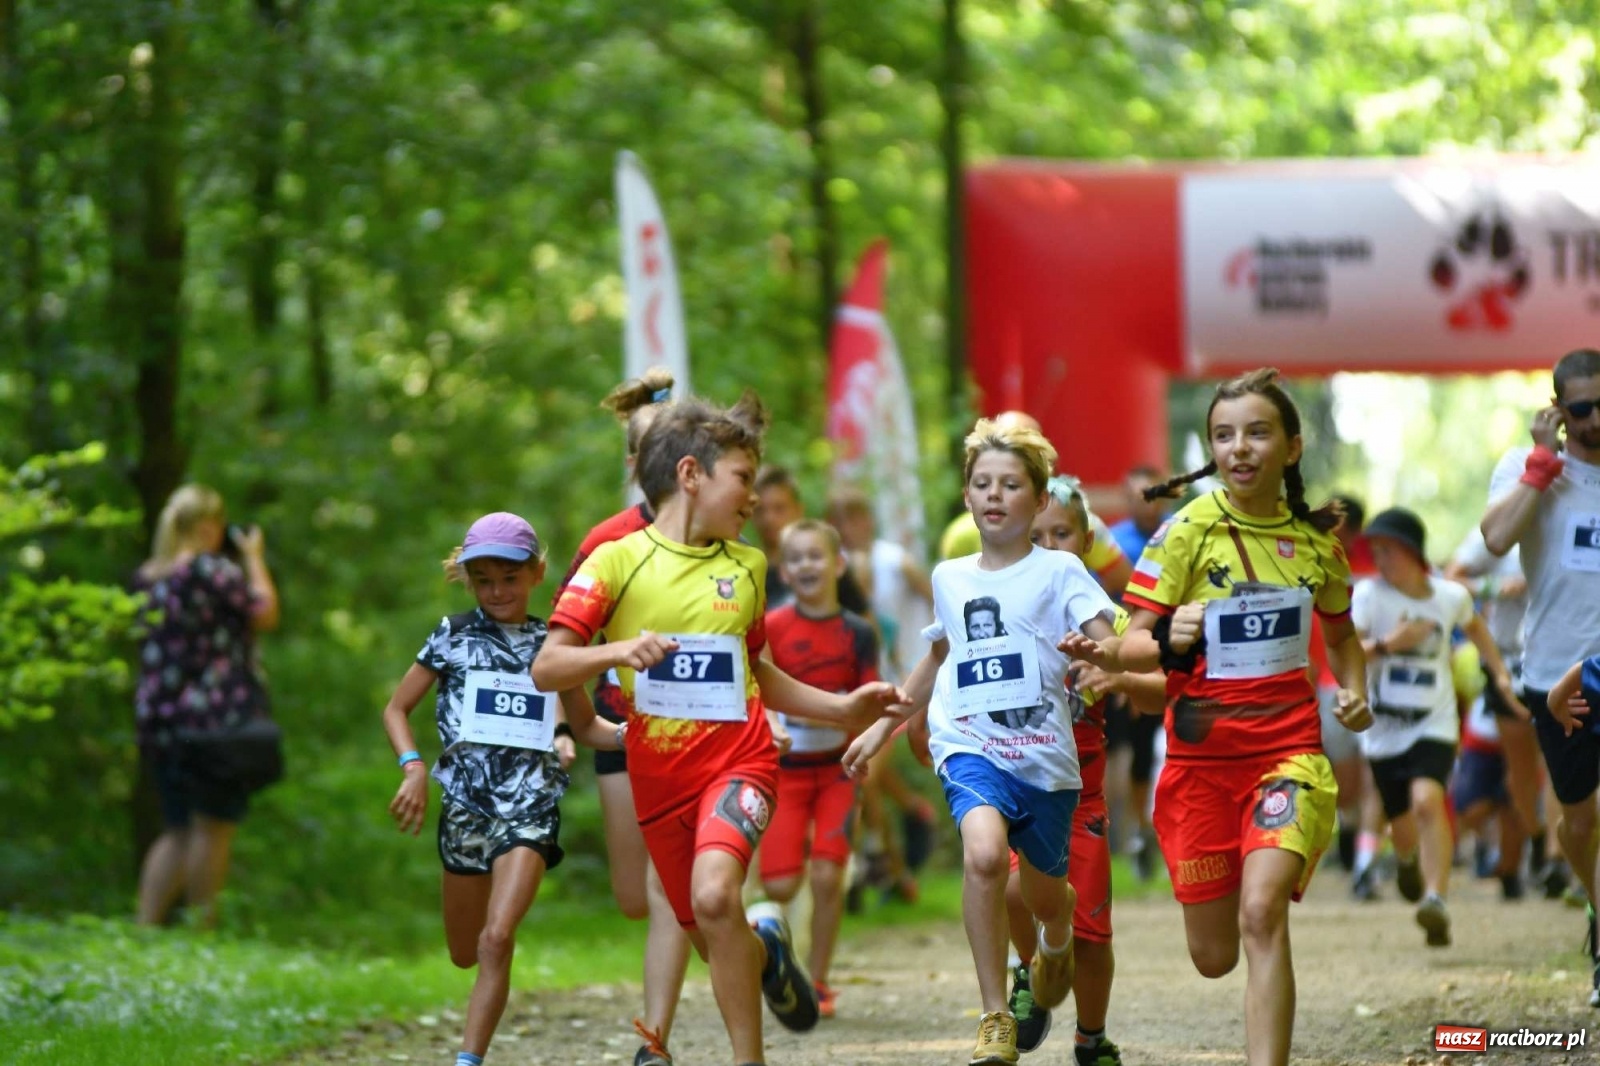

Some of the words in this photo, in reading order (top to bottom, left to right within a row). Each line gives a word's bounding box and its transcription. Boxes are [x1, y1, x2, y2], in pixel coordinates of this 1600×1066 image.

[1243, 612, 1280, 639] 97
[672, 654, 712, 679] 87
[972, 658, 1003, 682] 16
[494, 692, 527, 716] 96
